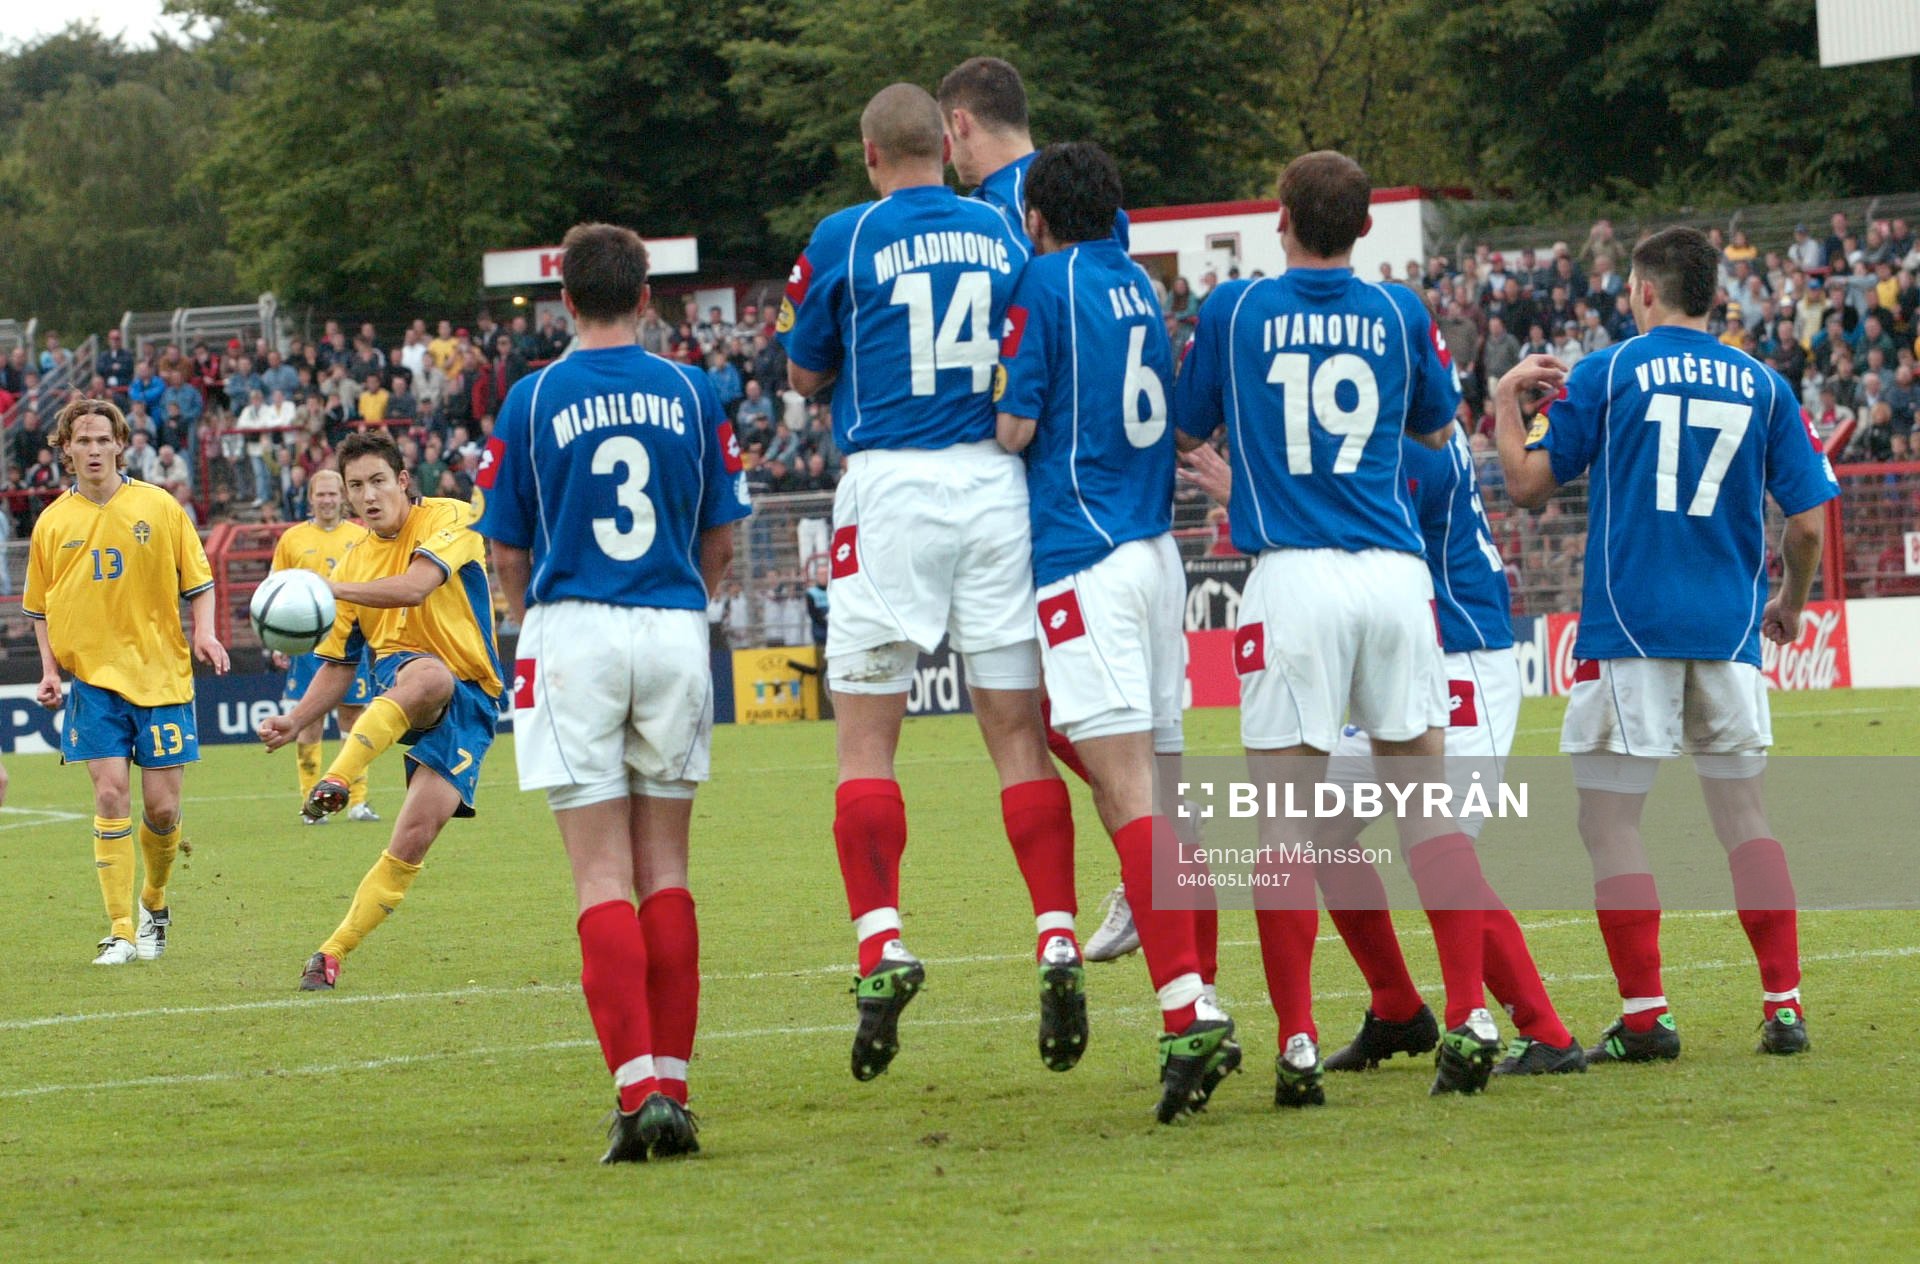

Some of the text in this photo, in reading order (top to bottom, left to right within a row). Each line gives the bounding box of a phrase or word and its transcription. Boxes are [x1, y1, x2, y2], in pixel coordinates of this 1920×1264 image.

[874, 230, 1011, 285] MILADINOVIĆ
[890, 271, 998, 396] 14
[1264, 313, 1386, 356] IVANOVIĆ
[1123, 325, 1167, 448] 6
[1635, 352, 1756, 400] VUKČEVIĆ
[552, 392, 685, 449] MIJAILOVIĆ
[1266, 353, 1380, 475] 19
[1645, 393, 1754, 516] 17
[591, 435, 657, 561] 3
[91, 549, 123, 581] 13
[356, 678, 367, 698] 3
[151, 723, 183, 757] 13
[451, 748, 473, 776] 7
